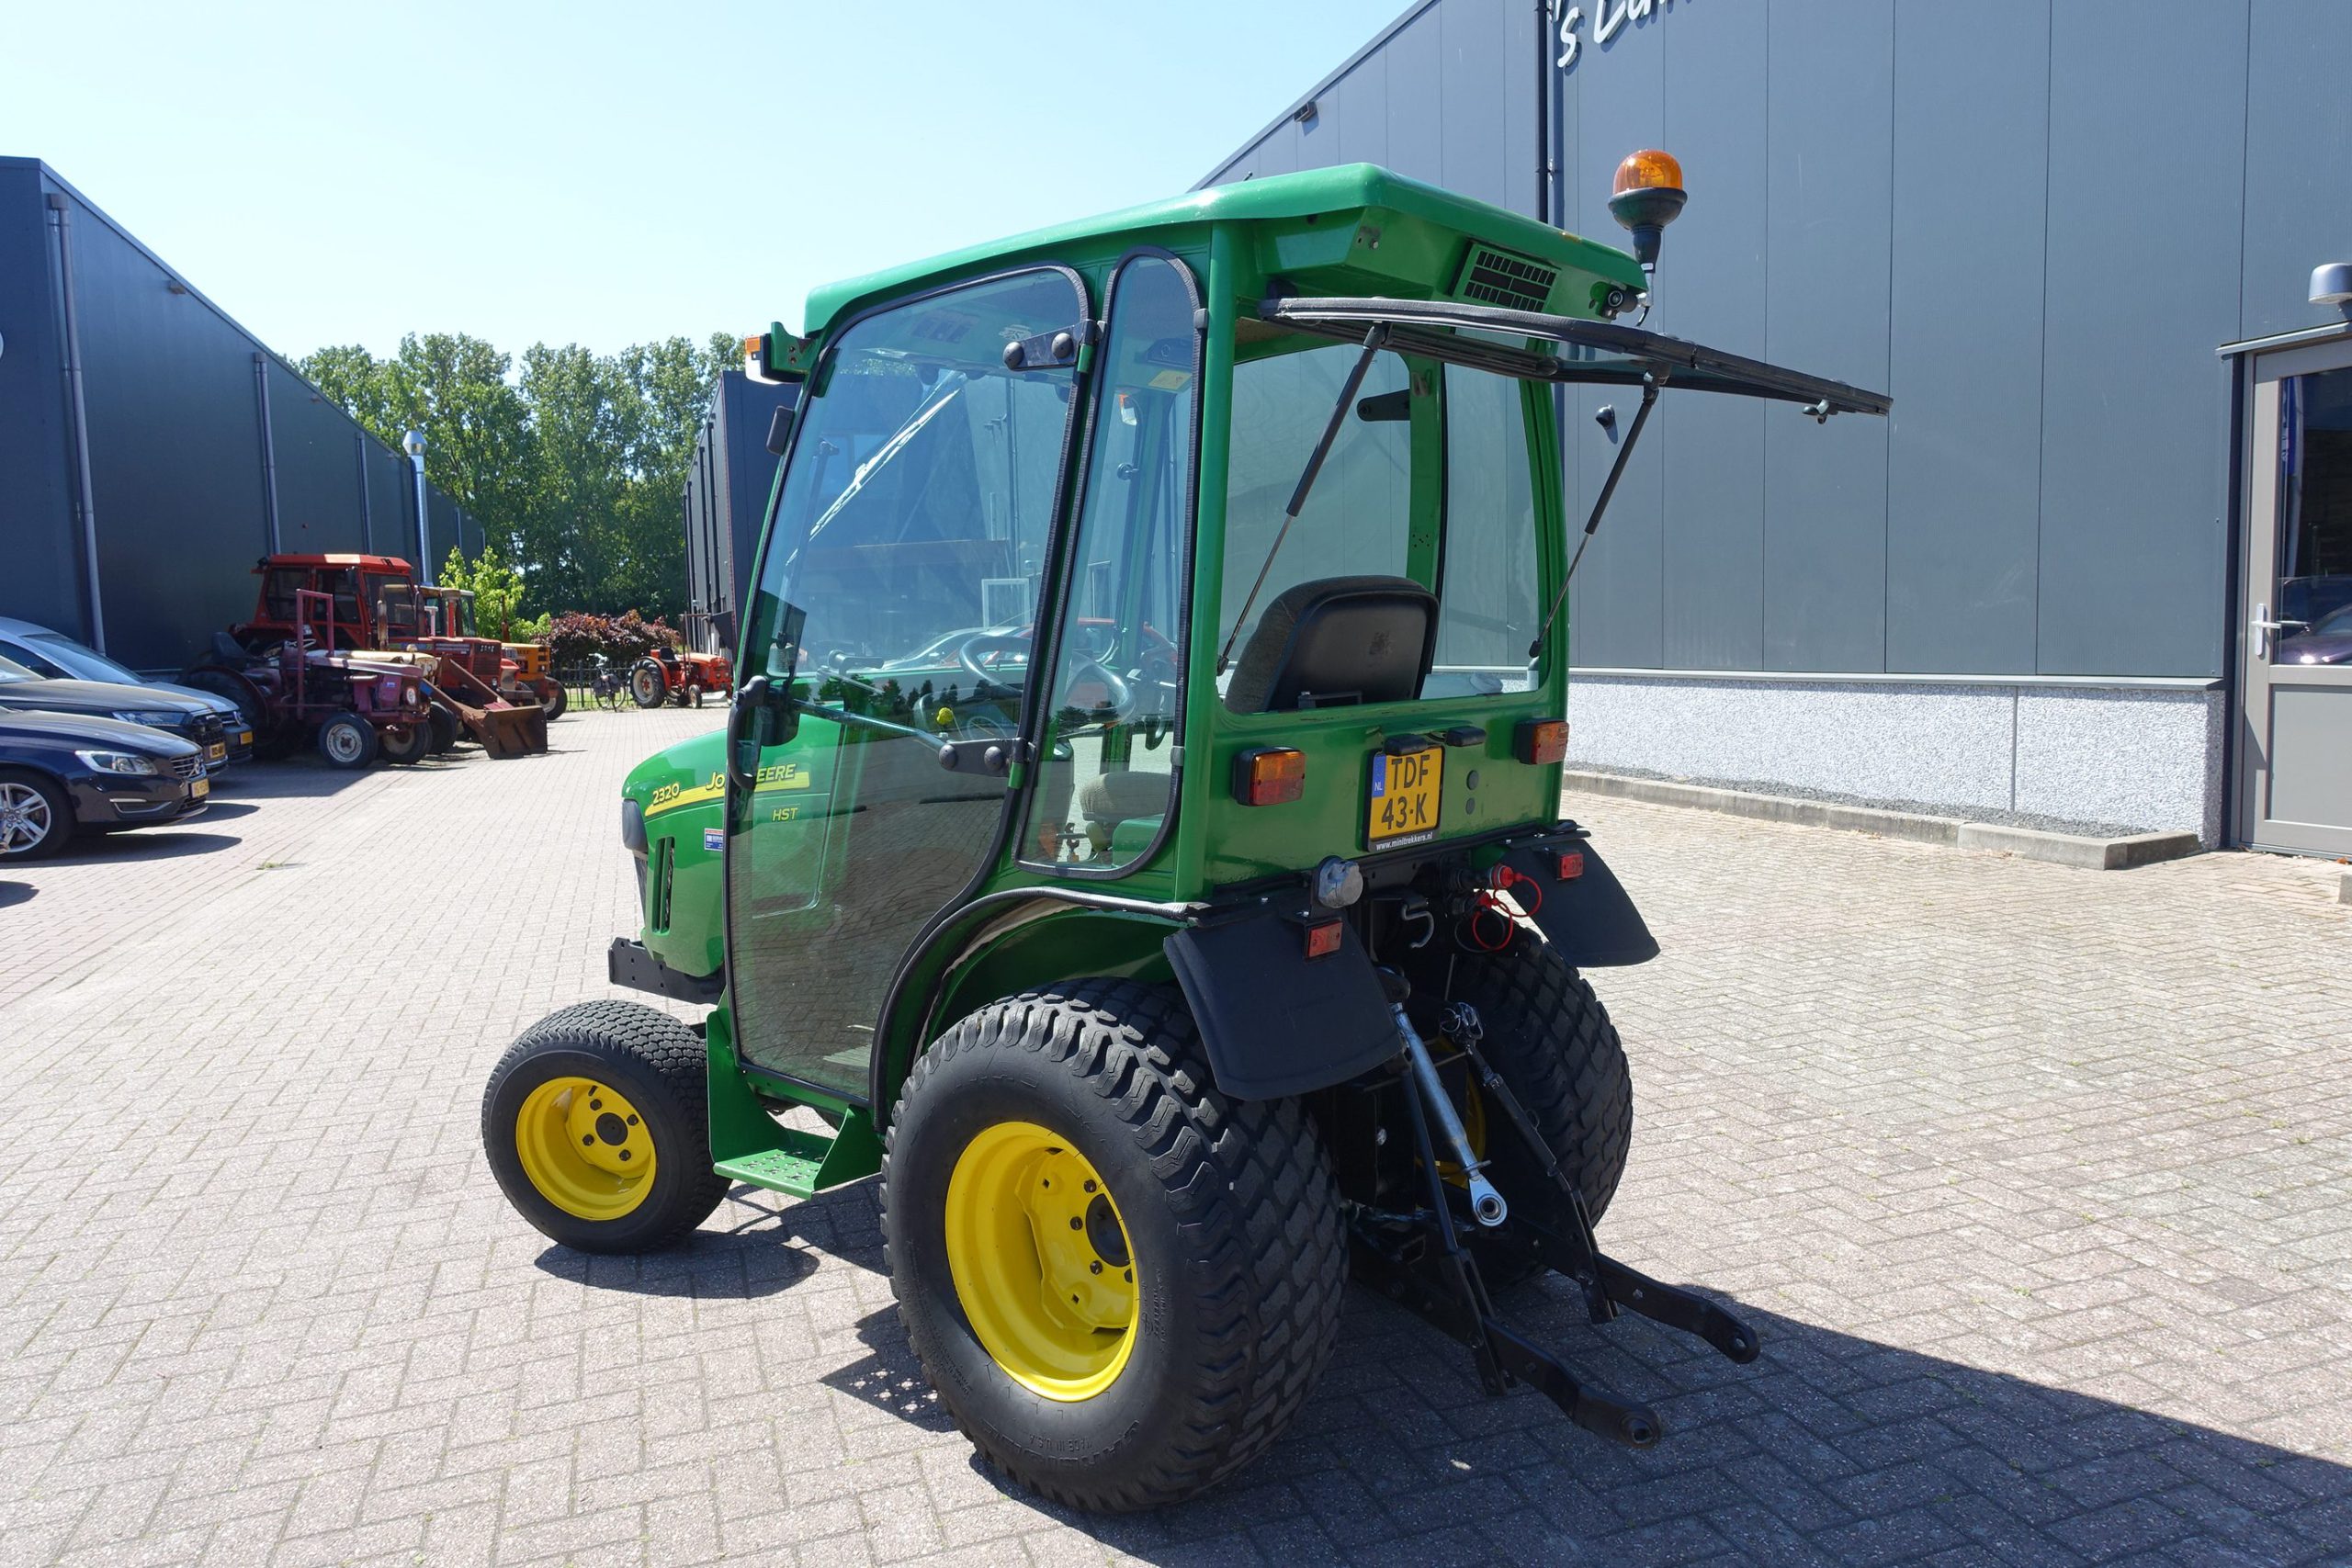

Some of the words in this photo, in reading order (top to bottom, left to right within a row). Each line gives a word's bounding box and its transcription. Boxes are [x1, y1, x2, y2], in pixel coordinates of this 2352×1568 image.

[756, 763, 797, 783] EERE
[1391, 755, 1430, 791] TDF
[652, 783, 680, 805] 2320
[1374, 781, 1383, 792] NL
[772, 807, 798, 822] HST
[1381, 793, 1427, 830] 43-K
[1375, 831, 1434, 851] www.minitrekkers.nl
